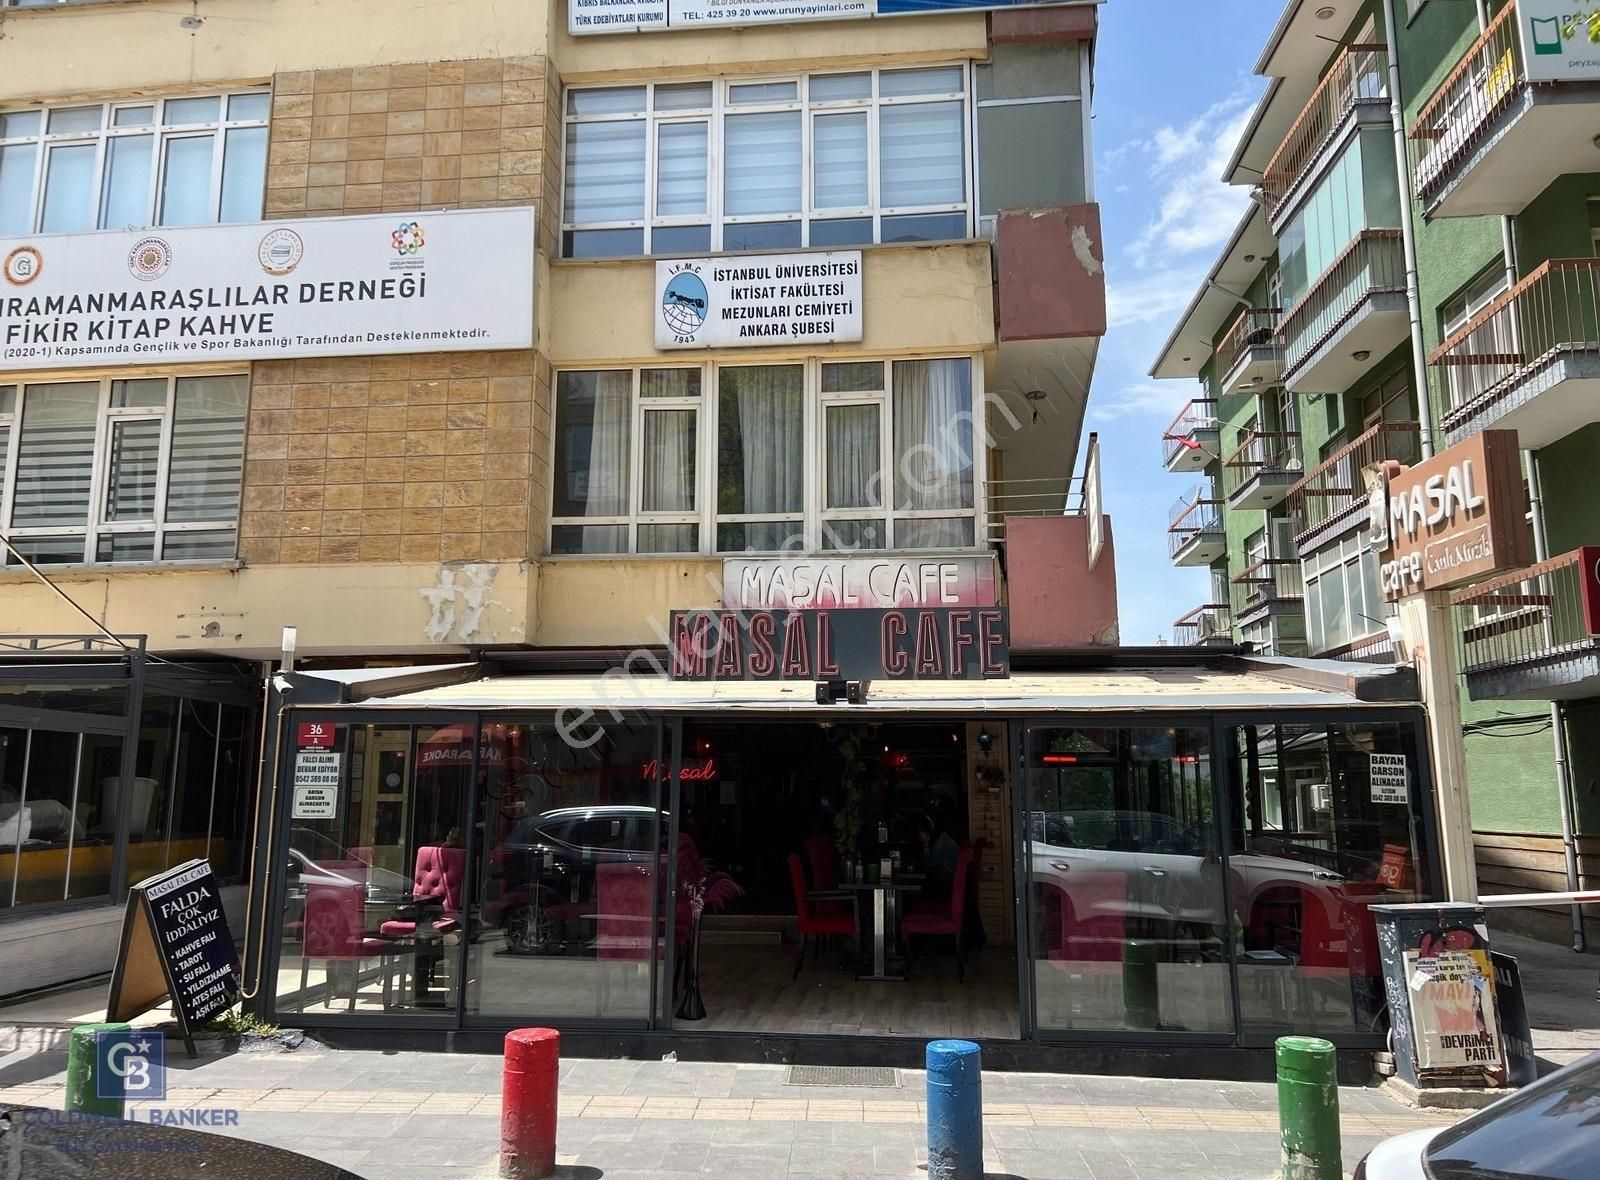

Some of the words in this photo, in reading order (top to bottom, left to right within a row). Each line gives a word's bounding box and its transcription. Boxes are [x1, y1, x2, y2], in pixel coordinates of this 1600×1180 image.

[637, 12, 664, 23] KURUMU
[682, 12, 704, 20] TEL:
[706, 10, 723, 18] 425
[726, 9, 737, 18] 39
[739, 9, 751, 17] 20
[753, 2, 864, 16] www.urunyayinlari.com
[713, 267, 771, 282] İSTANBUL
[775, 259, 858, 279] ÜNİVERSİTESİ
[300, 272, 426, 303] DERNEĞİ
[731, 285, 776, 300] İKTİSAT
[780, 281, 844, 298] FAKÜLTESİ
[721, 306, 790, 320] MEZUNLARI
[795, 300, 853, 317] CEMİYETİ
[6, 317, 79, 344] FİKİR
[88, 314, 171, 341] KİTAP
[180, 313, 274, 336] KAHVE
[674, 334, 696, 344] 1943
[739, 324, 787, 337] ANKARA
[791, 318, 835, 338] ŞUBESİ
[4, 346, 51, 359] (2020-1)
[56, 344, 130, 357] Kapsamında
[133, 341, 179, 353] Gençlik
[183, 341, 197, 350] ve
[201, 339, 230, 350] Spor
[234, 336, 292, 348] Bakanlığı
[296, 333, 363, 346] Tarafından
[367, 328, 491, 342] Desteklenmektedir.
[1389, 459, 1485, 542] MASAL
[1380, 551, 1423, 594] cafe
[740, 564, 859, 606] MASAL
[869, 563, 961, 605] CAFE
[672, 612, 840, 678] MASAL
[881, 611, 1004, 676] CAFE
[310, 724, 323, 735] 36
[1371, 755, 1404, 766] BAYAN
[1371, 766, 1405, 777] GARSON
[1371, 777, 1406, 787] ALINACAK
[148, 881, 176, 897] MASAL
[175, 875, 189, 886] FAL
[190, 864, 210, 879] CAFE
[160, 886, 212, 919] FALDA
[165, 908, 220, 943] İDDALIYIZ
[177, 904, 202, 925] ÇOK
[175, 939, 202, 959] KAHVE
[200, 930, 217, 946] FALI
[178, 951, 203, 971] TAROT
[183, 971, 195, 983] SU
[194, 961, 211, 977] FALI
[186, 963, 232, 994] YILDIZNAME
[192, 990, 210, 1007] ATEŞ
[209, 981, 226, 996] FALI
[195, 1003, 211, 1019] AŞK
